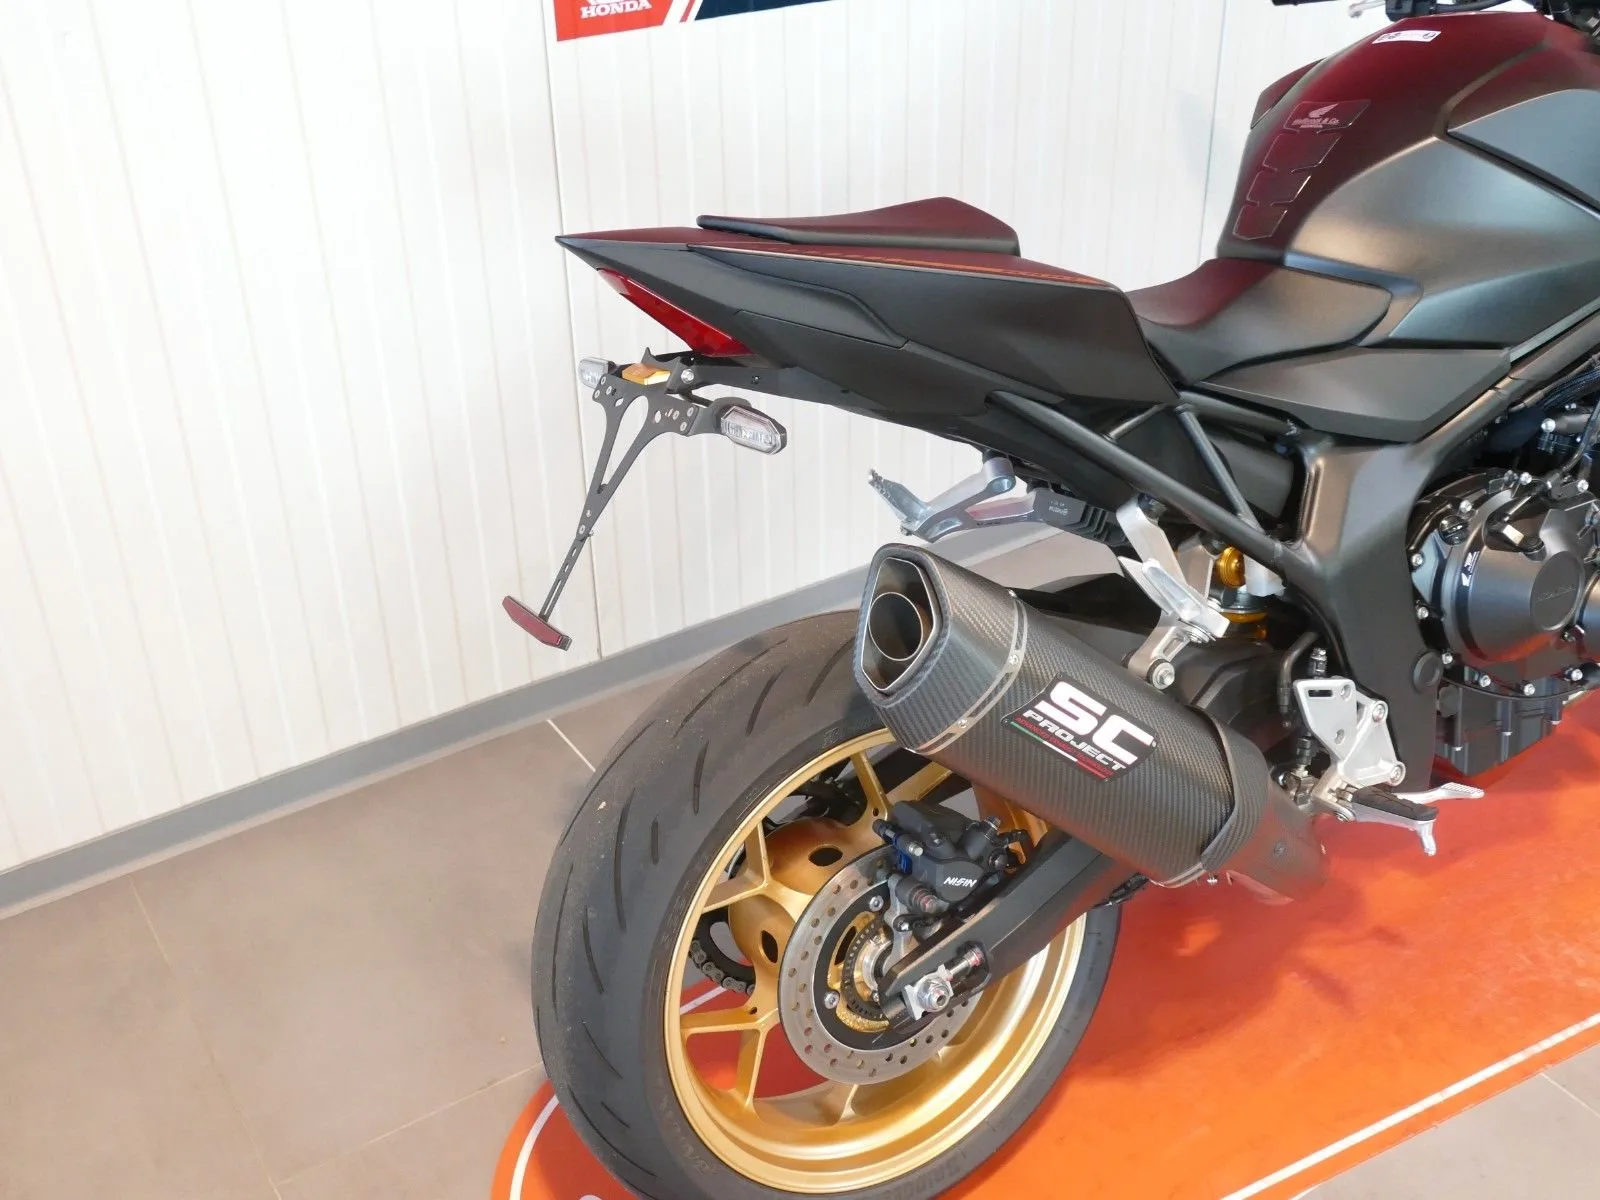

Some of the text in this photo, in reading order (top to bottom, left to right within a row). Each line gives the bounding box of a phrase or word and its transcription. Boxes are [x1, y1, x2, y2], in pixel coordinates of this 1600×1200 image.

[580, 1, 652, 18] HONDA
[1022, 709, 1127, 771] PROJECT
[1034, 681, 1155, 765] SC
